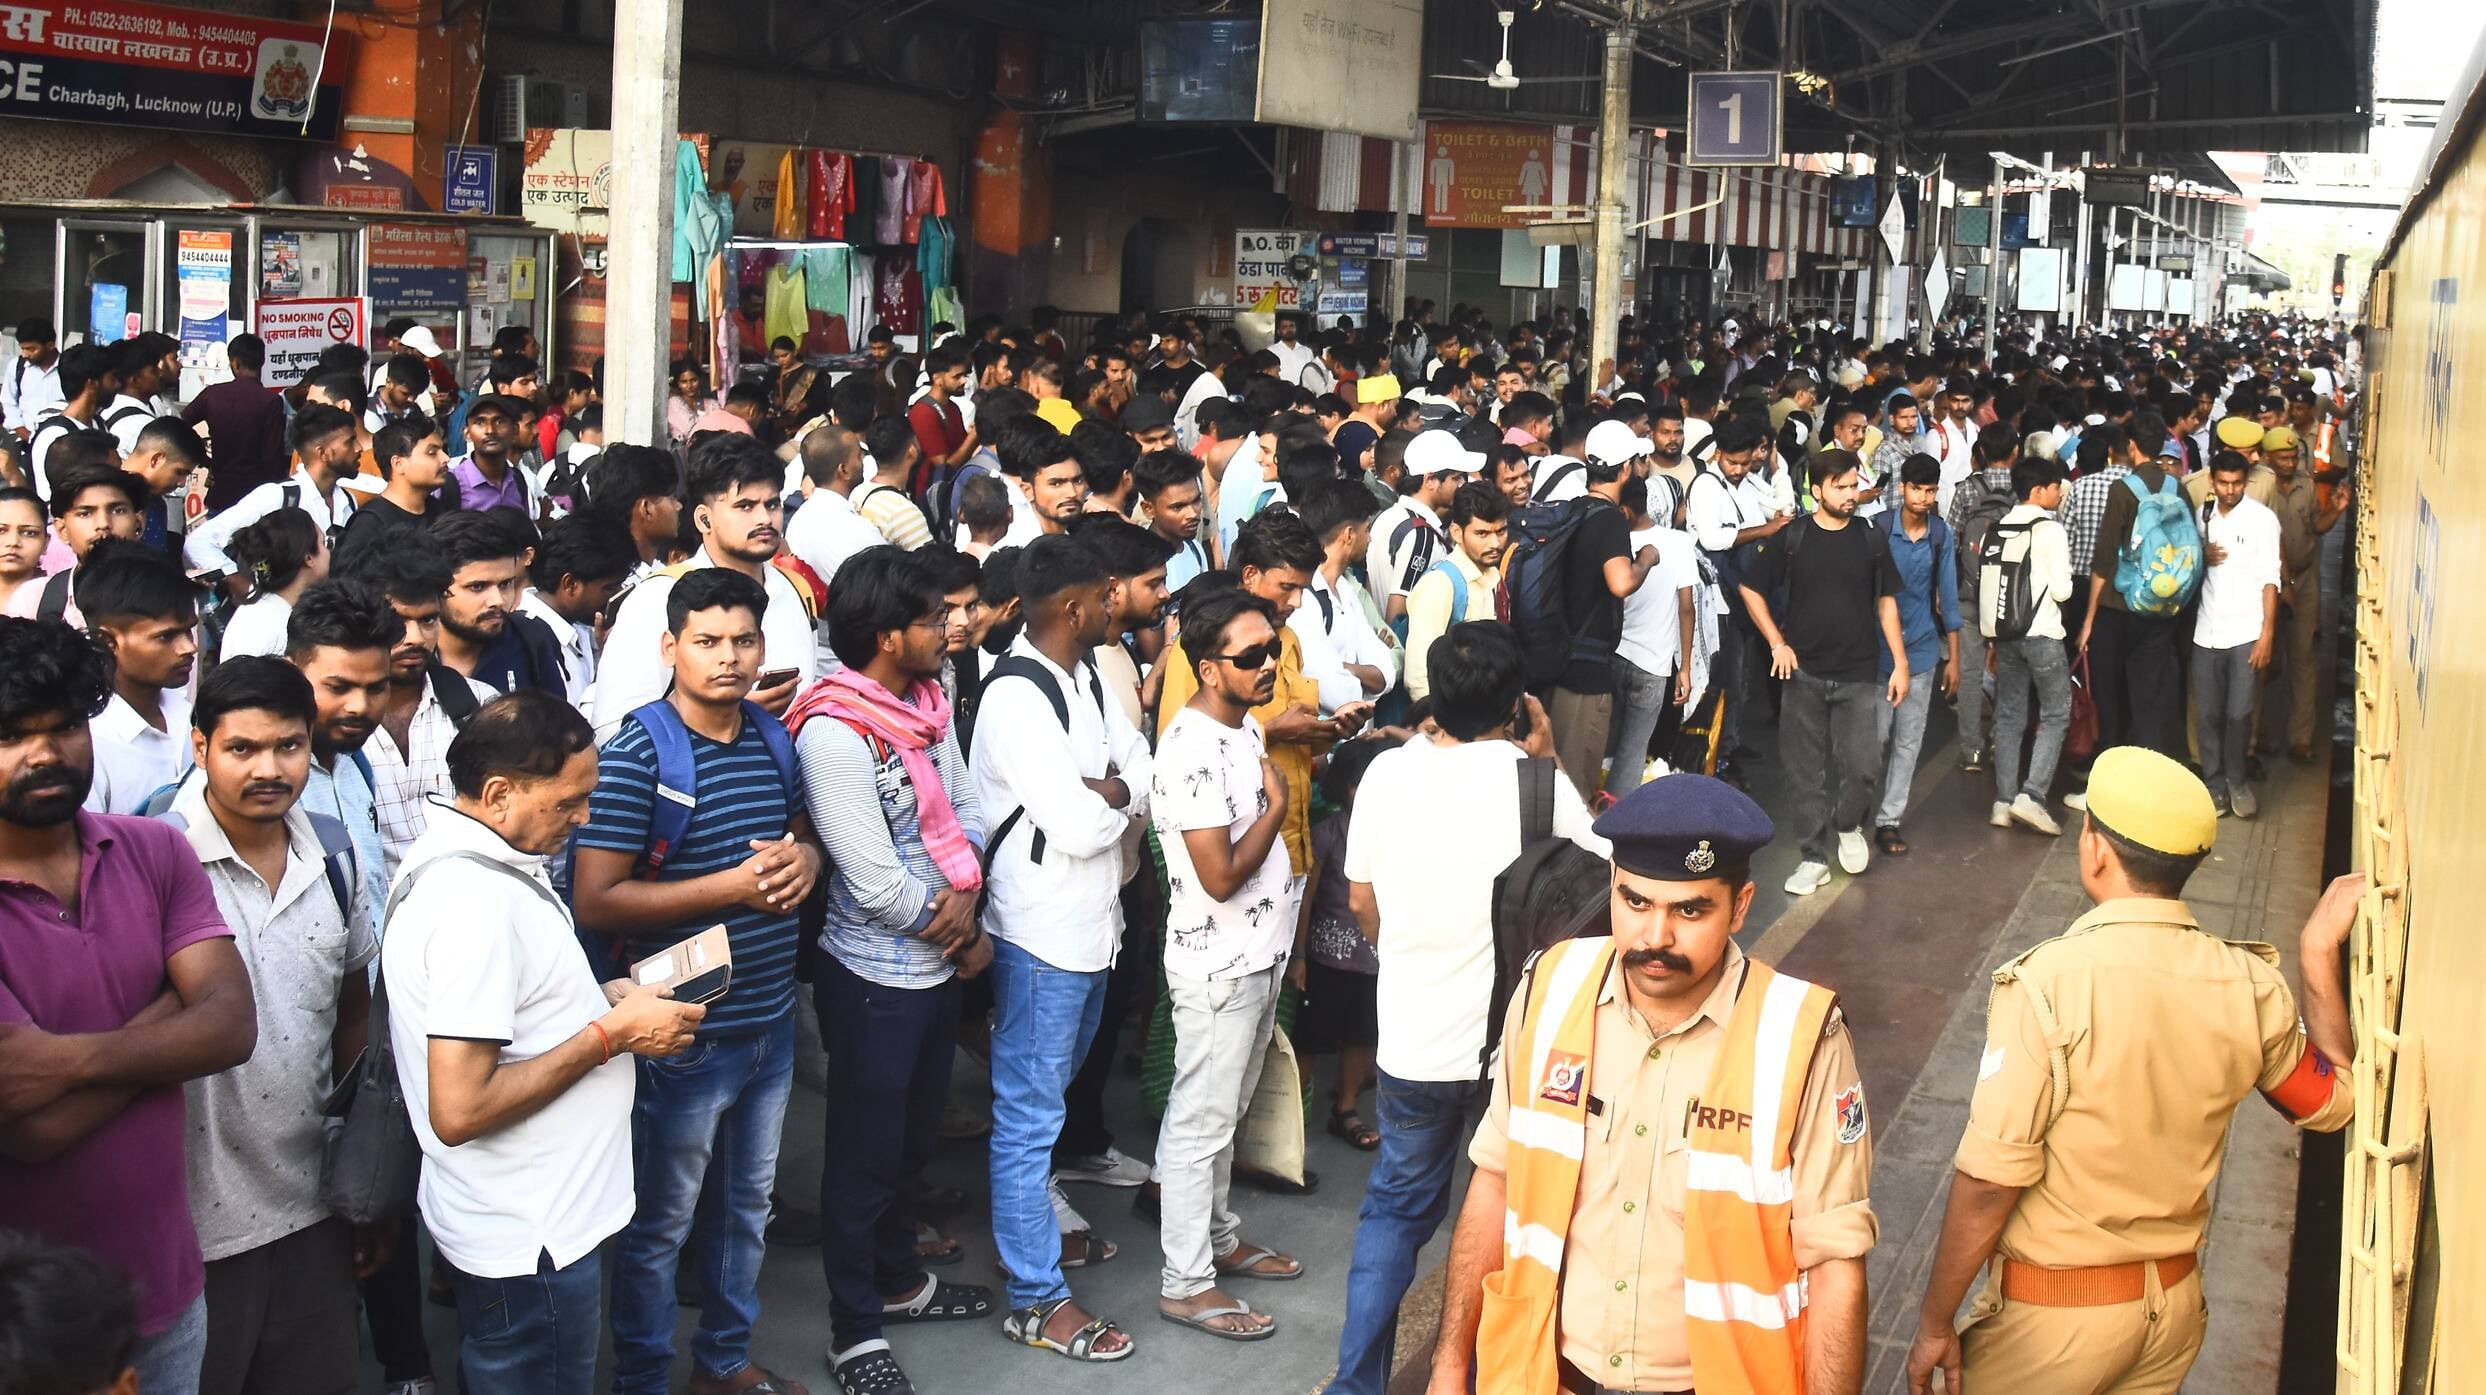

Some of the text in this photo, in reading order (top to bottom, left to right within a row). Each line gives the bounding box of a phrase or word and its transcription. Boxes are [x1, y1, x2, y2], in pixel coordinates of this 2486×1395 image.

[64, 7, 87, 25] PH.:
[89, 11, 163, 38] 0522-2636192,
[199, 25, 257, 46] 9454404405
[123, 40, 192, 63] लखनऊ
[49, 85, 242, 122] Charbagh, Lucknow (U.P.)
[1718, 93, 1742, 144] 1
[1433, 133, 1548, 149] TOILET & BATH
[527, 174, 549, 189] एक
[552, 170, 591, 189] स्टेशन
[451, 198, 487, 208] COLD WATER
[527, 190, 589, 205] एक उत्पाद
[1460, 186, 1516, 201] TOILET
[181, 251, 228, 263] 9454404444
[1238, 257, 1262, 277] ठंडा
[1236, 285, 1244, 304] 5
[262, 312, 325, 324] NO SMOKING
[298, 325, 323, 339] निषेध
[1997, 574, 2009, 620] NIKE
[1697, 1106, 1753, 1133] RPF
